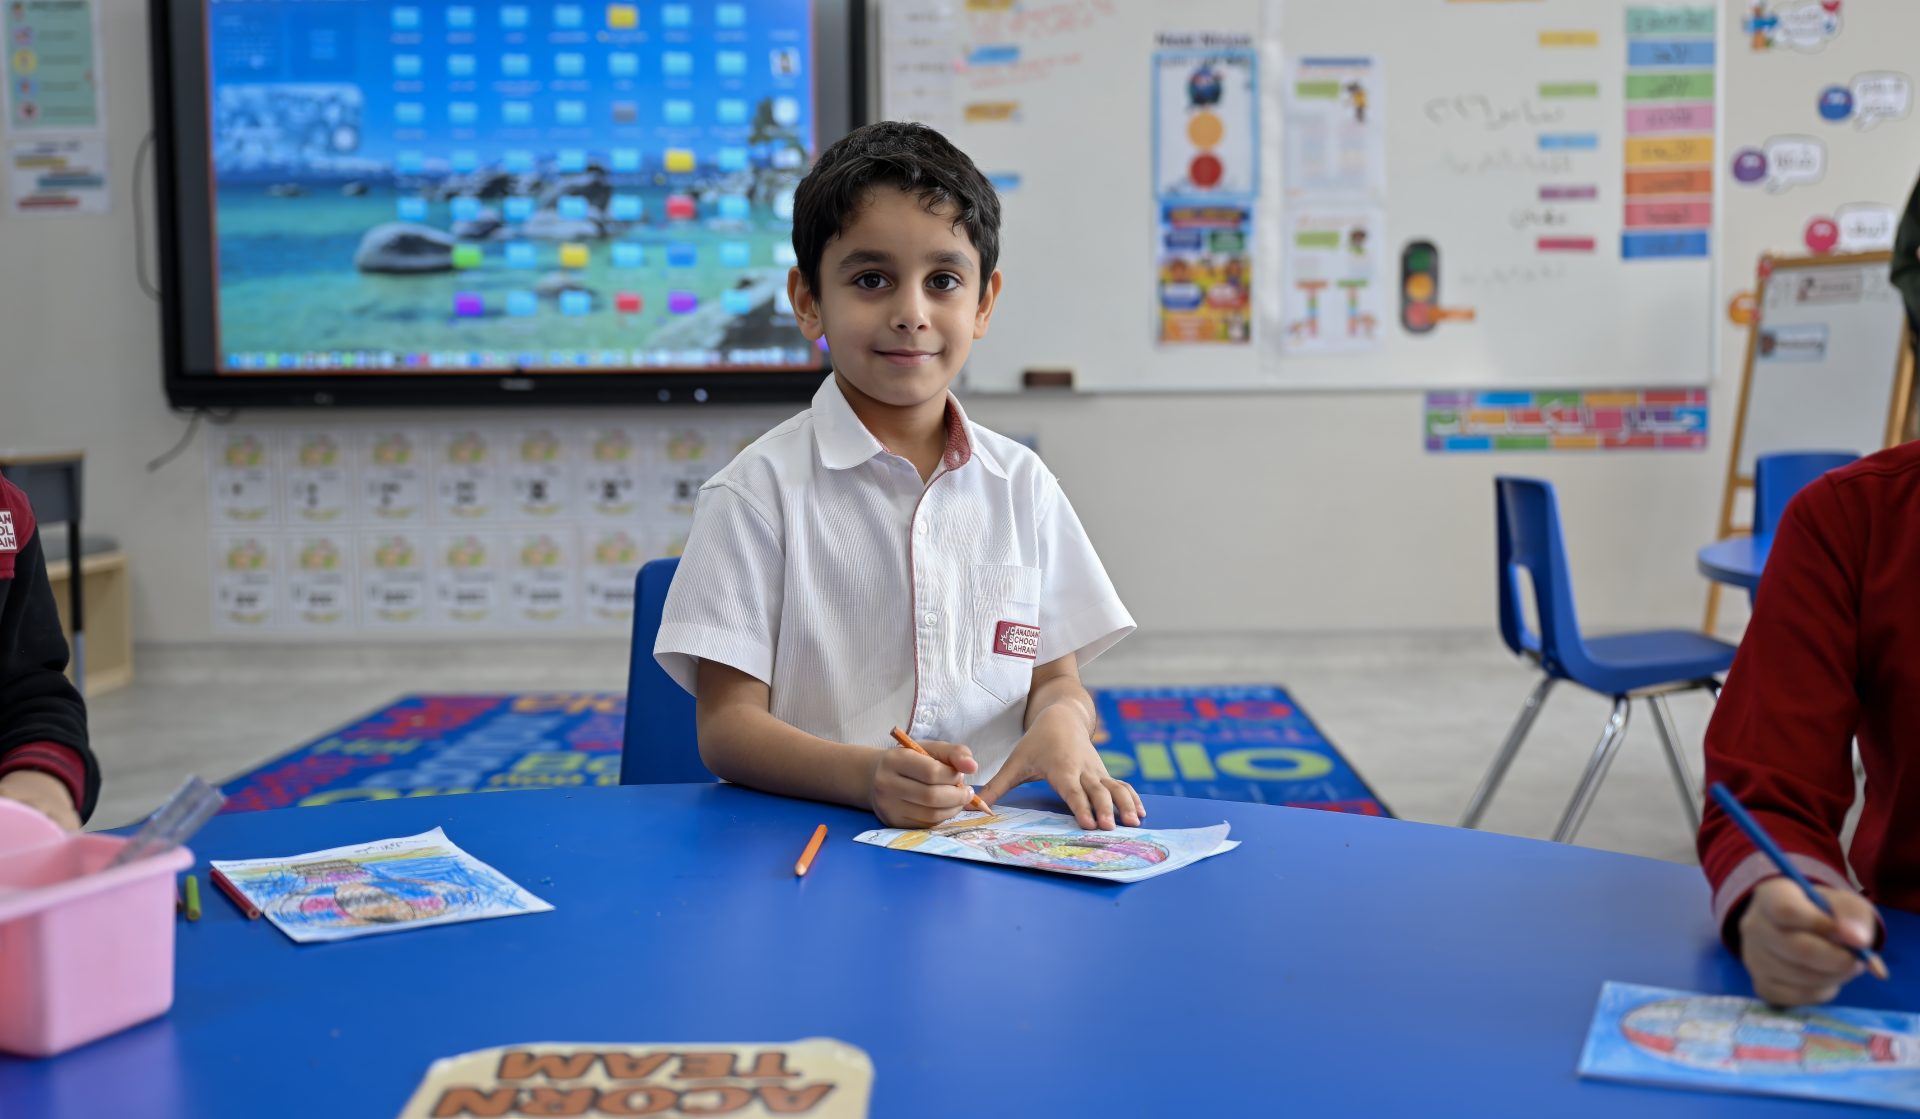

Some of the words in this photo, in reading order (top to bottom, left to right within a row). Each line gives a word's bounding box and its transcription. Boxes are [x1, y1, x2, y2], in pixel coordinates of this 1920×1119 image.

[1007, 643, 1037, 655] BAHRAIN
[1008, 635, 1037, 646] SCHOOL
[498, 1052, 801, 1081] TEAM
[430, 1085, 835, 1118] ACORN
